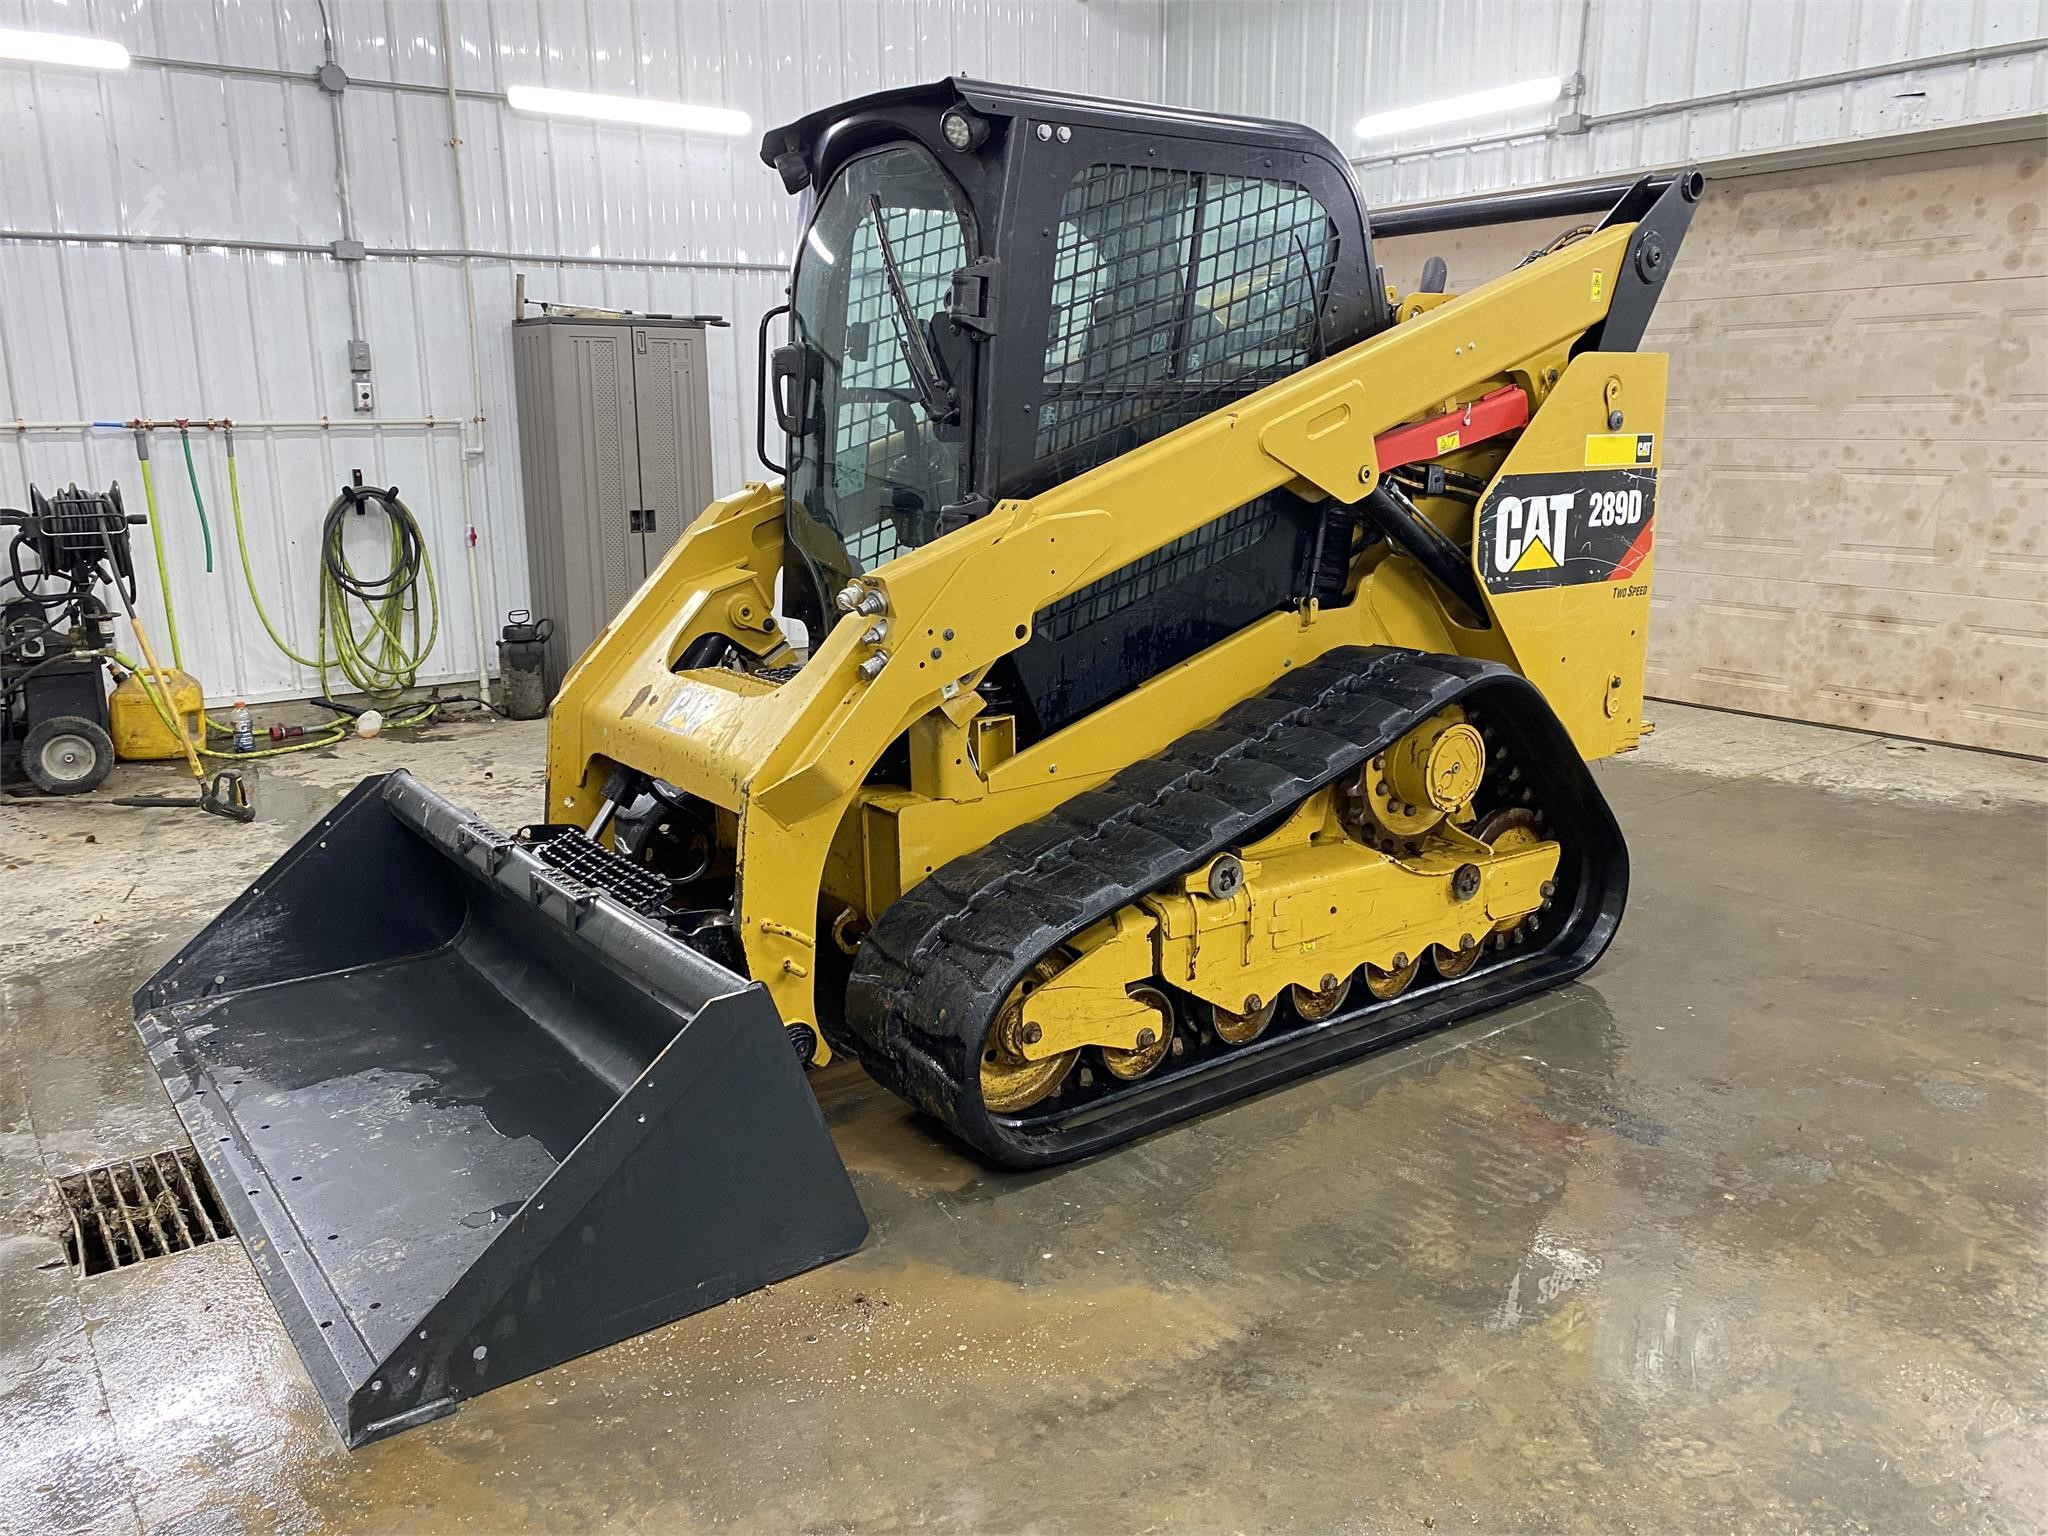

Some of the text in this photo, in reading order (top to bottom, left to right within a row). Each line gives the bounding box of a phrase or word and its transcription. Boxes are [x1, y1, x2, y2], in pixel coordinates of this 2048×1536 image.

[1637, 441, 1652, 457] CAT
[1494, 490, 1642, 573] CAT 289D
